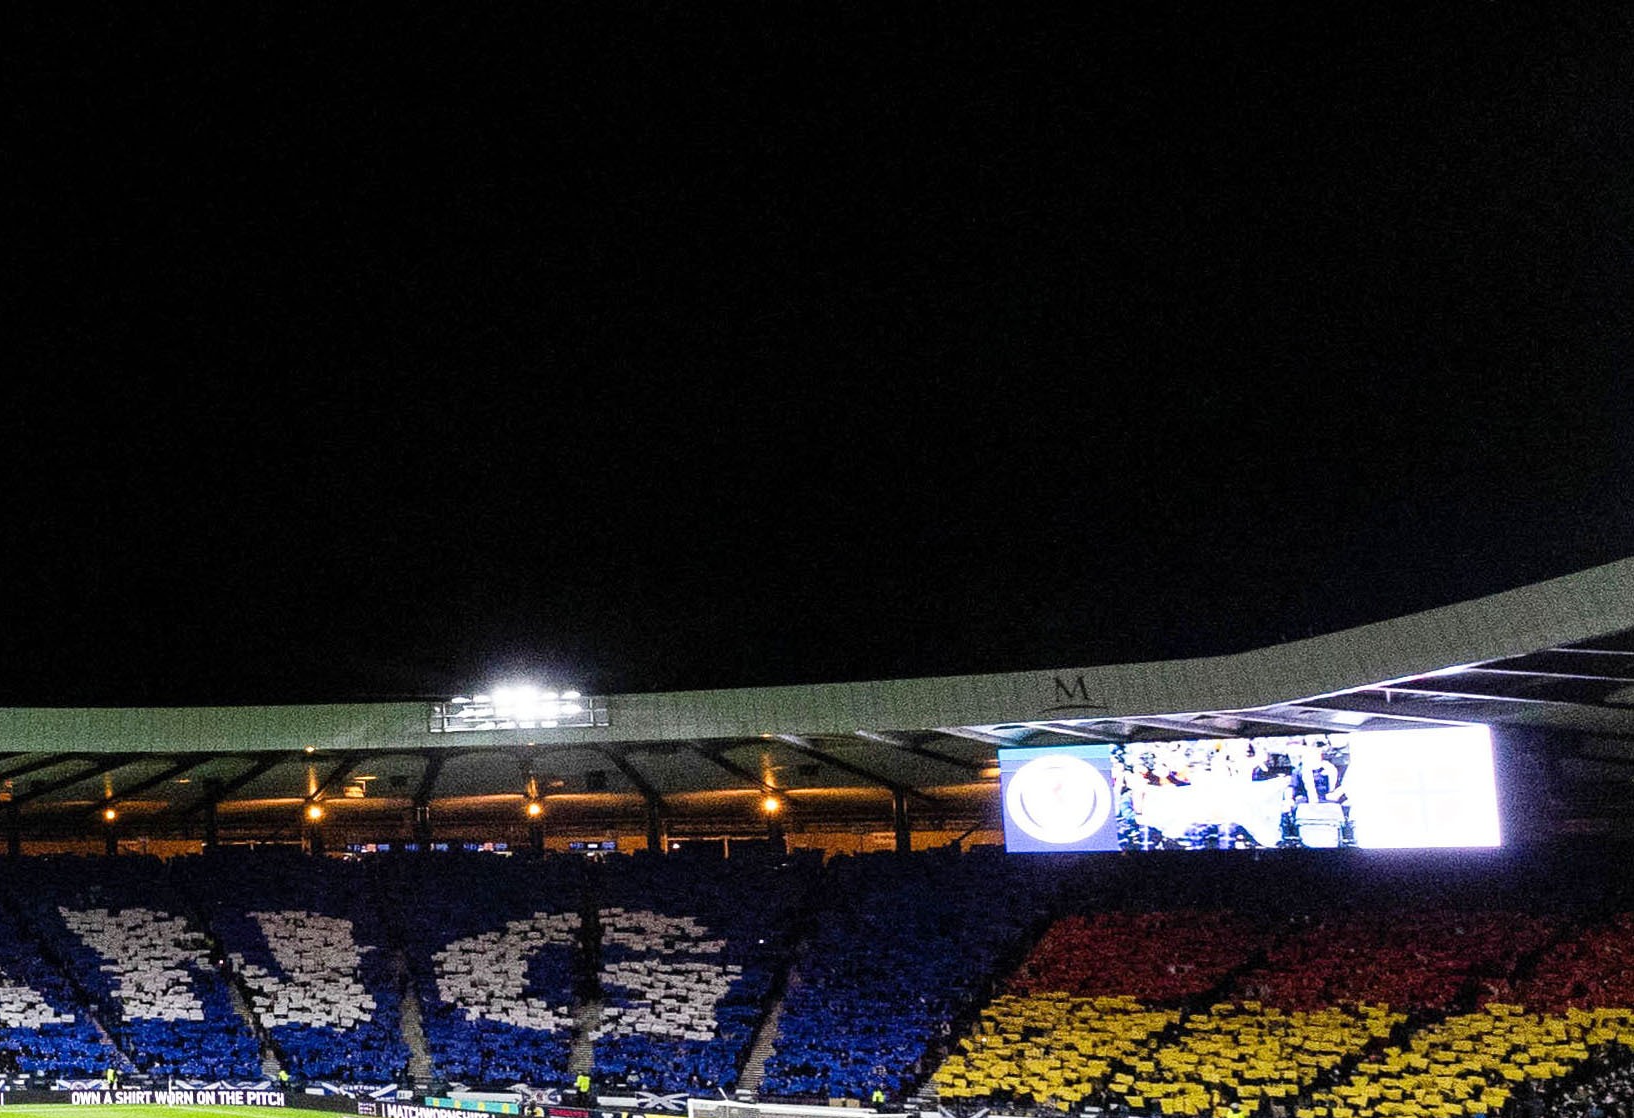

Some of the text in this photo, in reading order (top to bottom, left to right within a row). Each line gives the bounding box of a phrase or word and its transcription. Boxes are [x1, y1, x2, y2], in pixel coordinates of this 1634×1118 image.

[72, 1091, 284, 1107] OWN A SHIRT WORN ON THE PITCH
